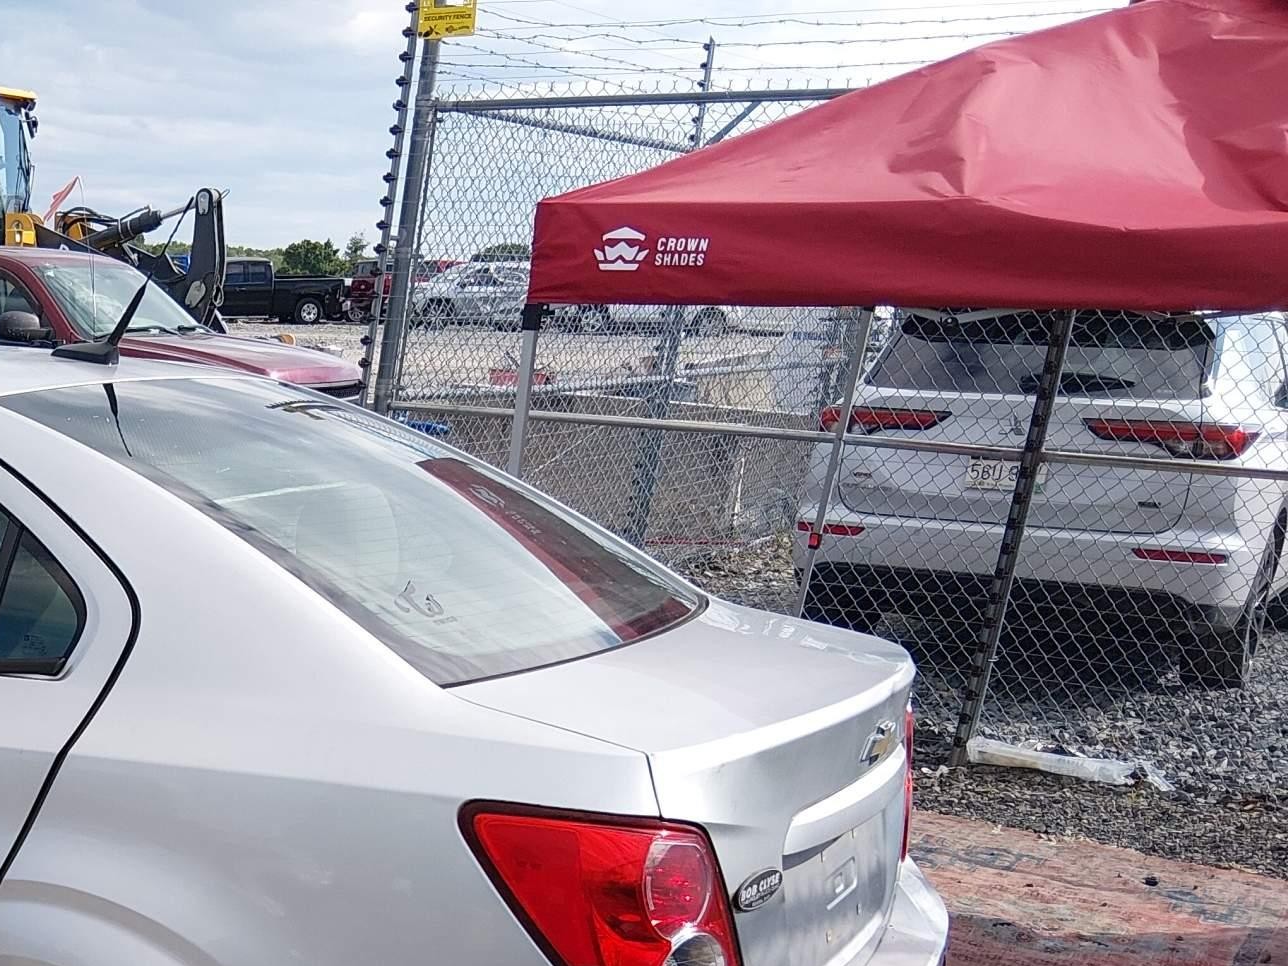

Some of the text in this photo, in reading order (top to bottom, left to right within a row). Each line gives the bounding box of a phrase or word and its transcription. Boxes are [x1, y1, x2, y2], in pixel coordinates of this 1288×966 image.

[656, 237, 710, 252] CROWN
[654, 253, 705, 267] SHADES
[740, 884, 758, 902] BOB
